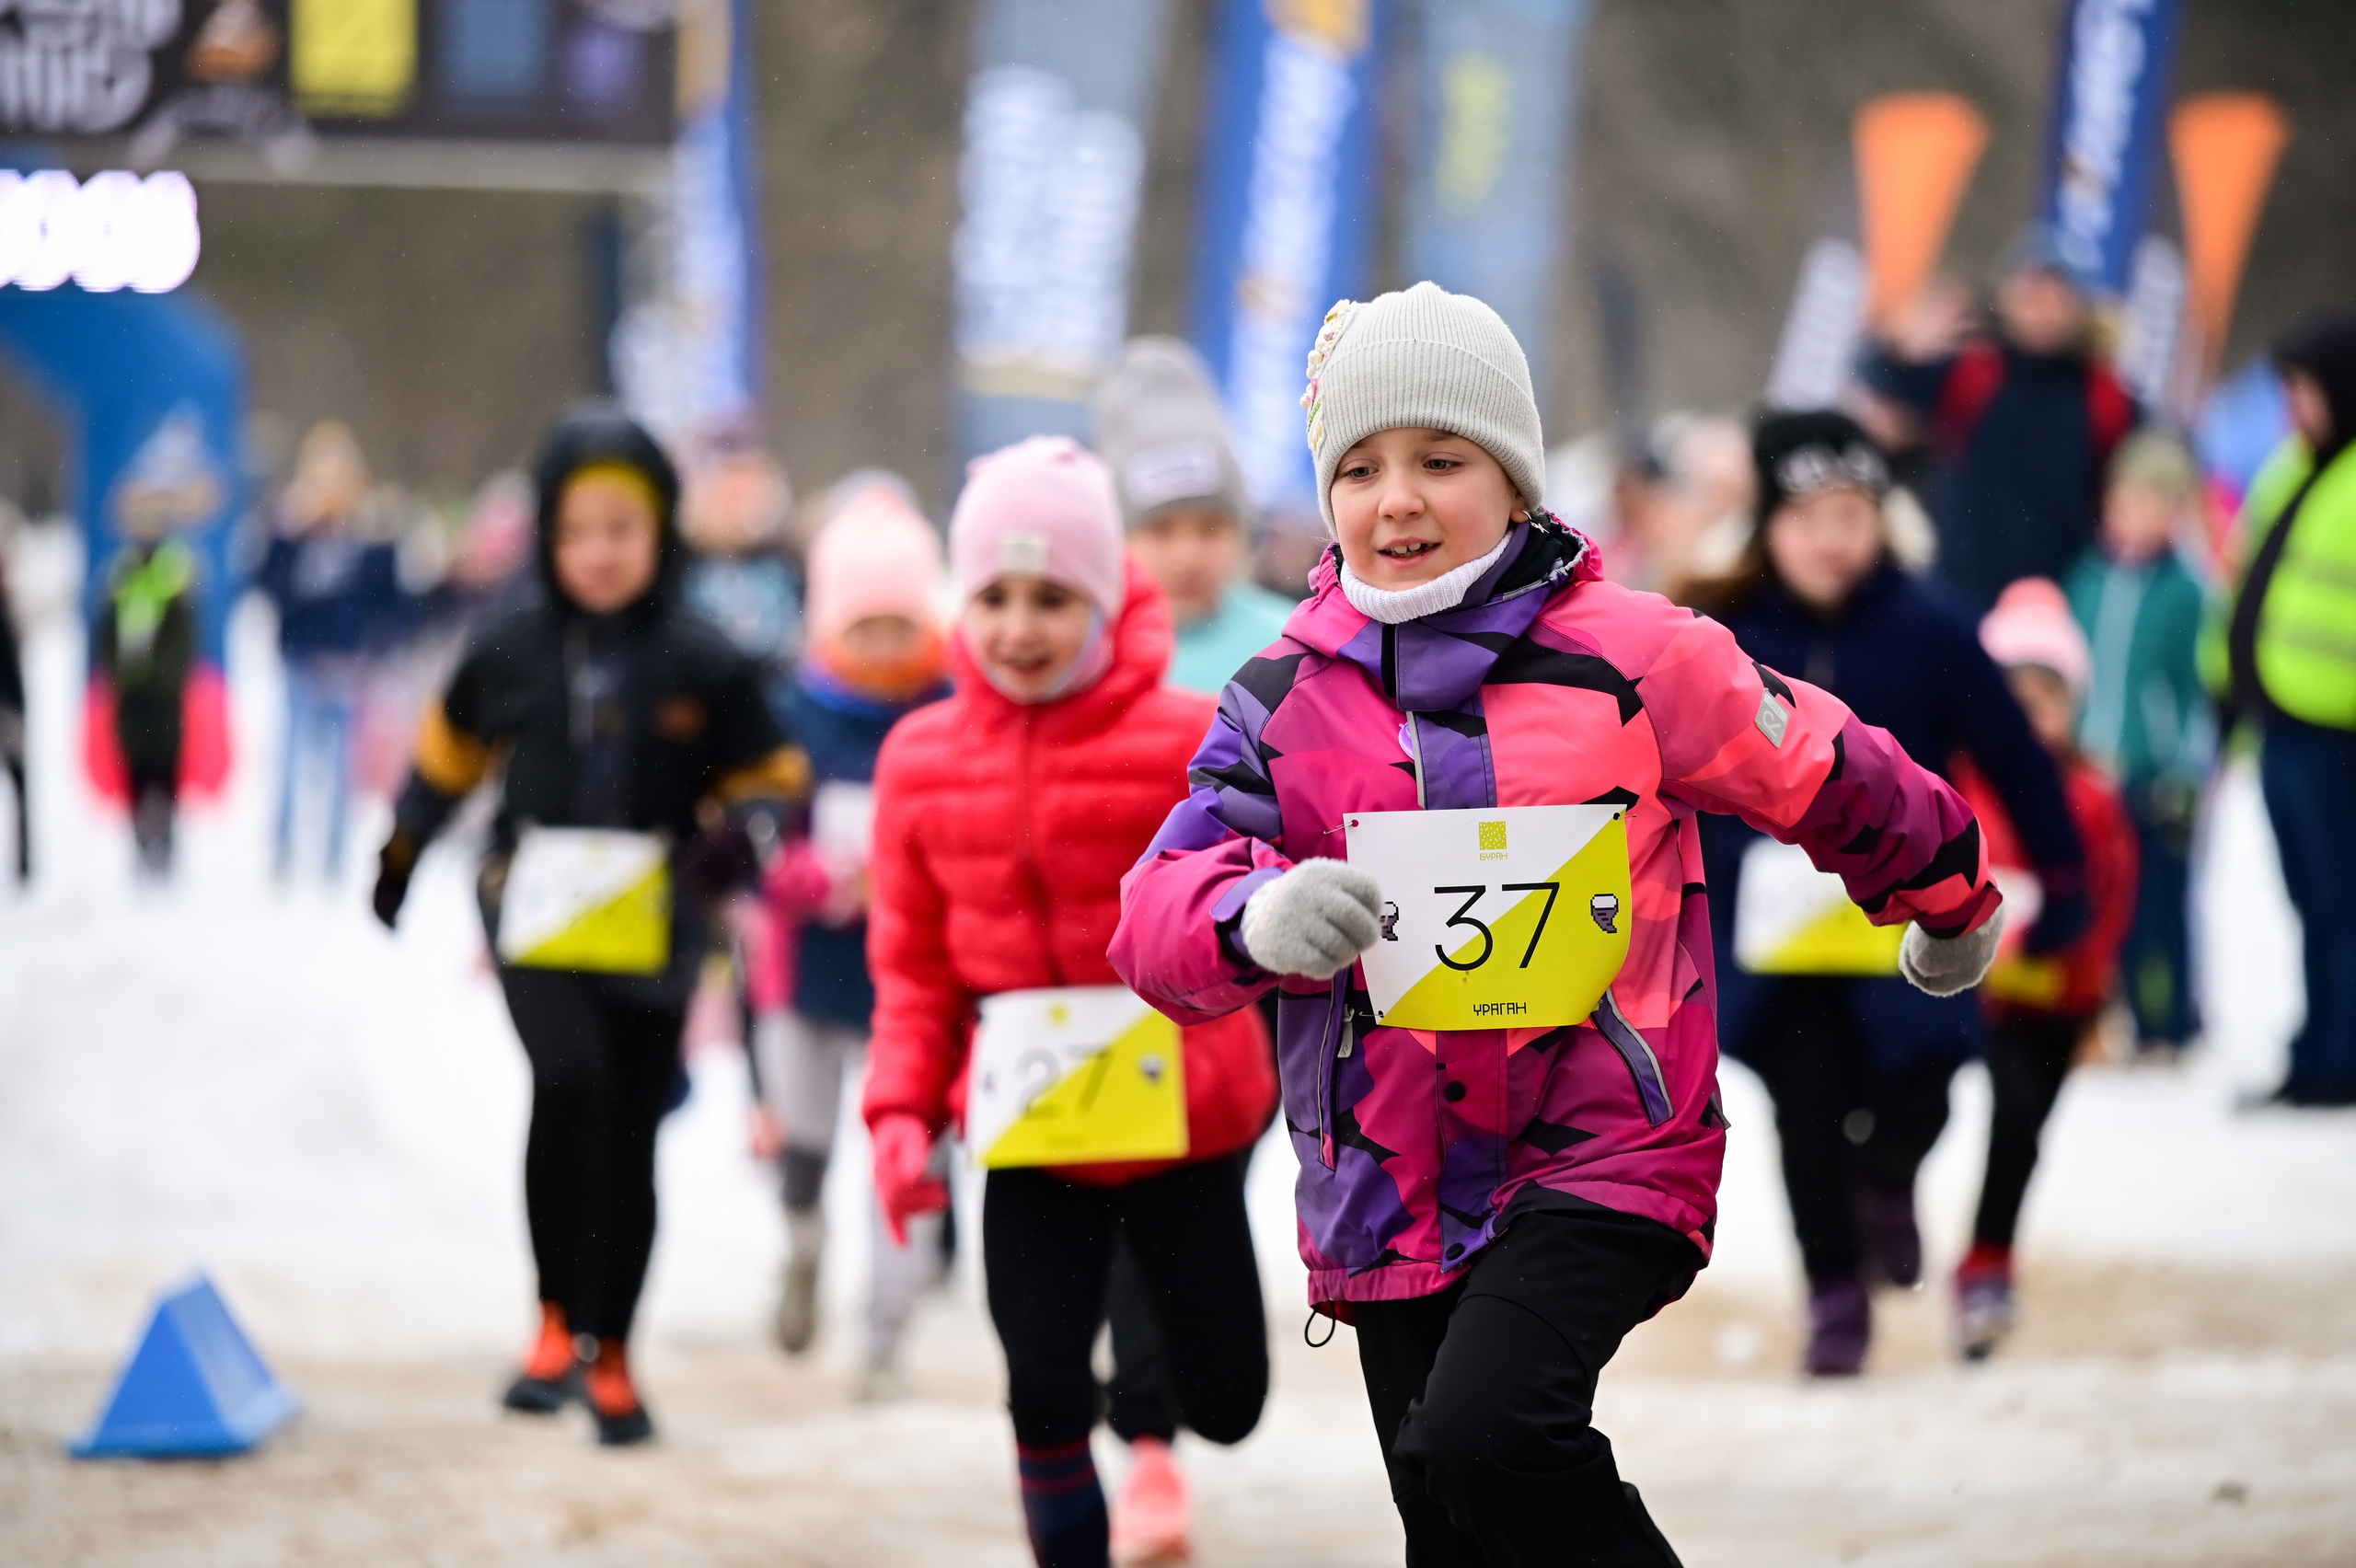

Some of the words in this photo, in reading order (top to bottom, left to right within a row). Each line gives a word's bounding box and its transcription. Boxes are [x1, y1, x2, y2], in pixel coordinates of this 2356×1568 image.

[1479, 852, 1507, 861] БУРАН
[1434, 882, 1560, 971] 37
[1472, 1001, 1527, 1016] УРАГАН
[1015, 1043, 1113, 1120] 27
